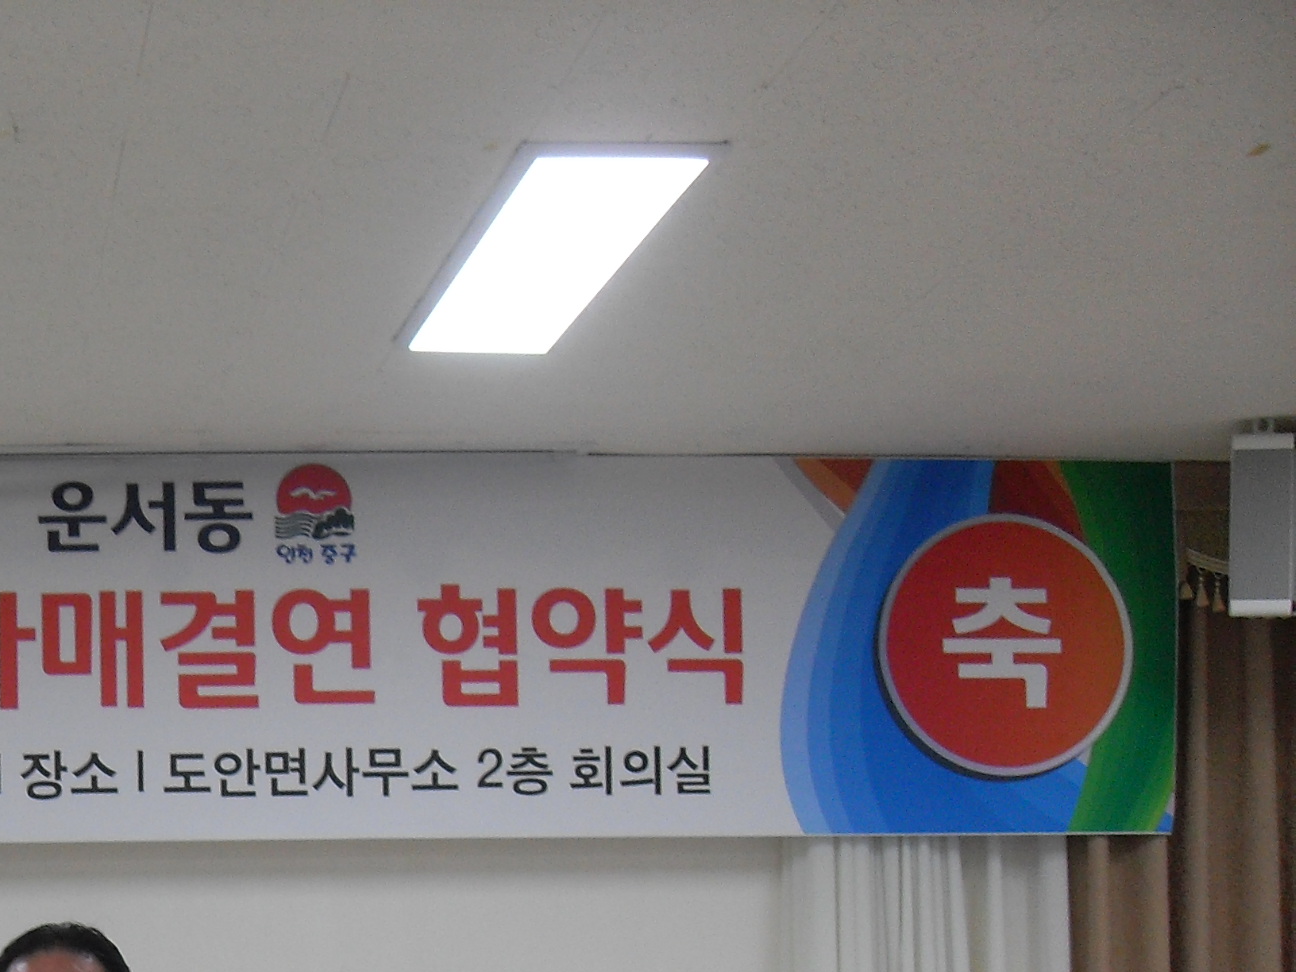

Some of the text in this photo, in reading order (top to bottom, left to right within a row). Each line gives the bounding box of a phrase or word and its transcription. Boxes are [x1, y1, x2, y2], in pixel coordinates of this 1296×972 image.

[37, 480, 253, 555] 운서동
[276, 543, 357, 565] 인천 중구
[417, 585, 745, 707] 협약식
[943, 577, 1061, 709] 축
[162, 749, 459, 799] 도안면사무소
[476, 747, 554, 799] 2층
[570, 743, 712, 797] 회의실
